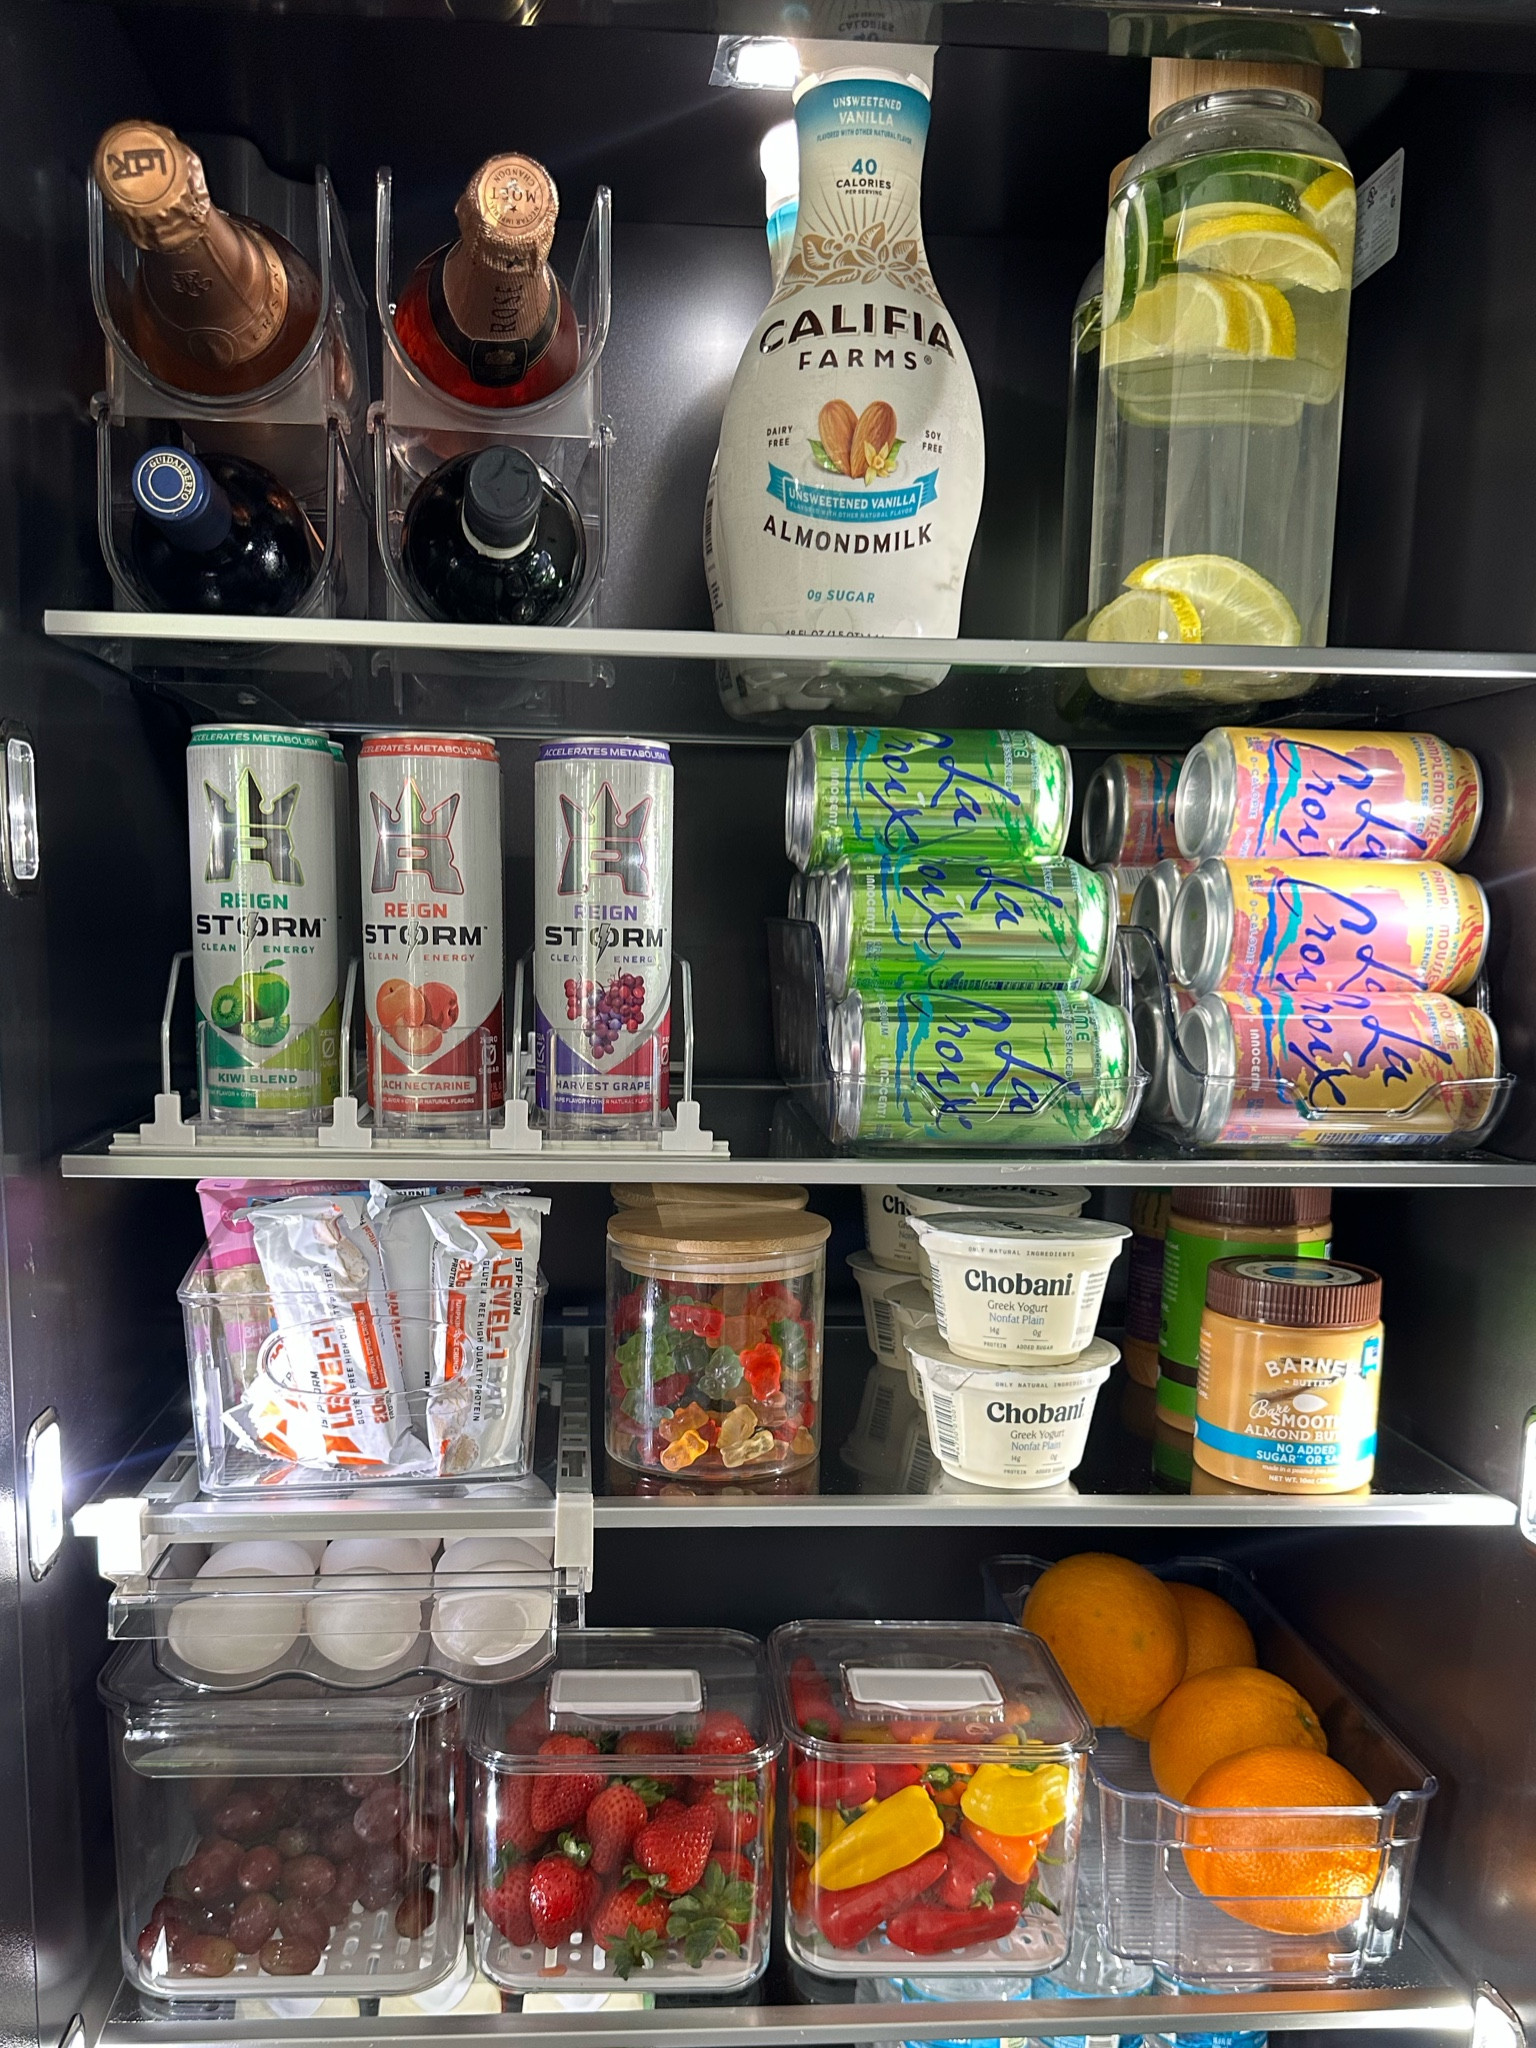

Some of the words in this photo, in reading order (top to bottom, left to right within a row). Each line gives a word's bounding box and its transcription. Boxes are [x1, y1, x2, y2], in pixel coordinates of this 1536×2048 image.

[833, 95, 902, 111] UNSWEETENED
[839, 111, 894, 127] VANILLA
[841, 128, 855, 137] WITH
[855, 127, 873, 136] OTHER
[874, 129, 897, 140] NATURAL
[851, 158, 878, 176] 40
[493, 167, 535, 187] CHANDON
[836, 178, 892, 190] CALORIES
[845, 188, 857, 196] PER
[858, 188, 883, 196] SERVING
[516, 206, 540, 226] NECTAR
[760, 303, 955, 360] CALIFIA
[766, 425, 794, 438] DAIRY
[924, 429, 943, 441] SOY
[768, 437, 791, 449] FREE
[921, 441, 944, 455] FREE
[149, 455, 194, 502] GUIDALBERTO
[788, 486, 869, 510] UNSWEETENED
[870, 492, 917, 509] VANILLA
[859, 511, 889, 519] NATURAL
[889, 506, 914, 517] FLAVOR
[763, 514, 933, 554] ALMONDMILK
[807, 589, 822, 602] 0g
[826, 589, 876, 604] SUGAR
[252, 733, 319, 747] METABOLISM
[413, 744, 482, 756] METABOLISM
[543, 747, 608, 757] ACCELERATES
[609, 747, 666, 761] METABOLISM
[1442, 796, 1455, 837] WATER
[220, 891, 289, 910] REIGN
[384, 901, 448, 919] REIGN
[574, 904, 638, 921] REIGN
[201, 942, 237, 953] CLEAN
[263, 944, 315, 954] ENERGY
[368, 951, 399, 961] CLEAN
[423, 953, 476, 962] ENERGY
[1445, 939, 1460, 979] WATER
[1072, 1002, 1091, 1042] LIME
[1424, 1002, 1441, 1047] ESSENCED
[1064, 1023, 1074, 1078] ESSENCED
[218, 1072, 246, 1084] KIWI
[249, 1074, 298, 1084] BLEND
[404, 1081, 471, 1091] NECTARINE
[556, 1079, 610, 1091] HARVEST
[612, 1081, 651, 1091] GRAPE
[279, 1186, 310, 1197] SOFT
[311, 1182, 351, 1194] BAKED
[989, 1247, 1021, 1256] NATURAL
[447, 1257, 459, 1288] PROTEIN
[964, 1268, 1074, 1297] Chobani
[486, 1256, 514, 1360] LEVEL-1
[987, 1299, 1016, 1311] Greek
[1017, 1301, 1049, 1314] Yogurt
[989, 1312, 1020, 1324] Nonfat
[1021, 1314, 1045, 1326] Plain
[476, 1321, 486, 1343] HIGH
[989, 1326, 1000, 1336] 14g
[1032, 1328, 1042, 1338] 0g
[342, 1342, 353, 1364] HIGH
[983, 1341, 1007, 1349] PROTEIN
[368, 1355, 380, 1385] PUMPKIN
[475, 1345, 485, 1382] QUALITY
[1264, 1357, 1348, 1378] BARNE
[312, 1326, 355, 1430] LEVEL-1
[347, 1367, 359, 1389] FREE
[1017, 1381, 1049, 1389] NATURAL
[484, 1365, 508, 1421] BAR
[472, 1384, 483, 1422] PROTEIN
[986, 1396, 1086, 1425] Chobani
[1249, 1399, 1291, 1419] Bare
[1010, 1429, 1037, 1440] Greek
[1039, 1429, 1065, 1441] Yogurt
[1244, 1423, 1312, 1441] ALMOND
[1011, 1441, 1040, 1451] Nonfat
[1276, 1443, 1294, 1453] NO
[1297, 1445, 1337, 1455] ADDED
[1305, 1455, 1322, 1465] OR
[1268, 1474, 1283, 1482] NET
